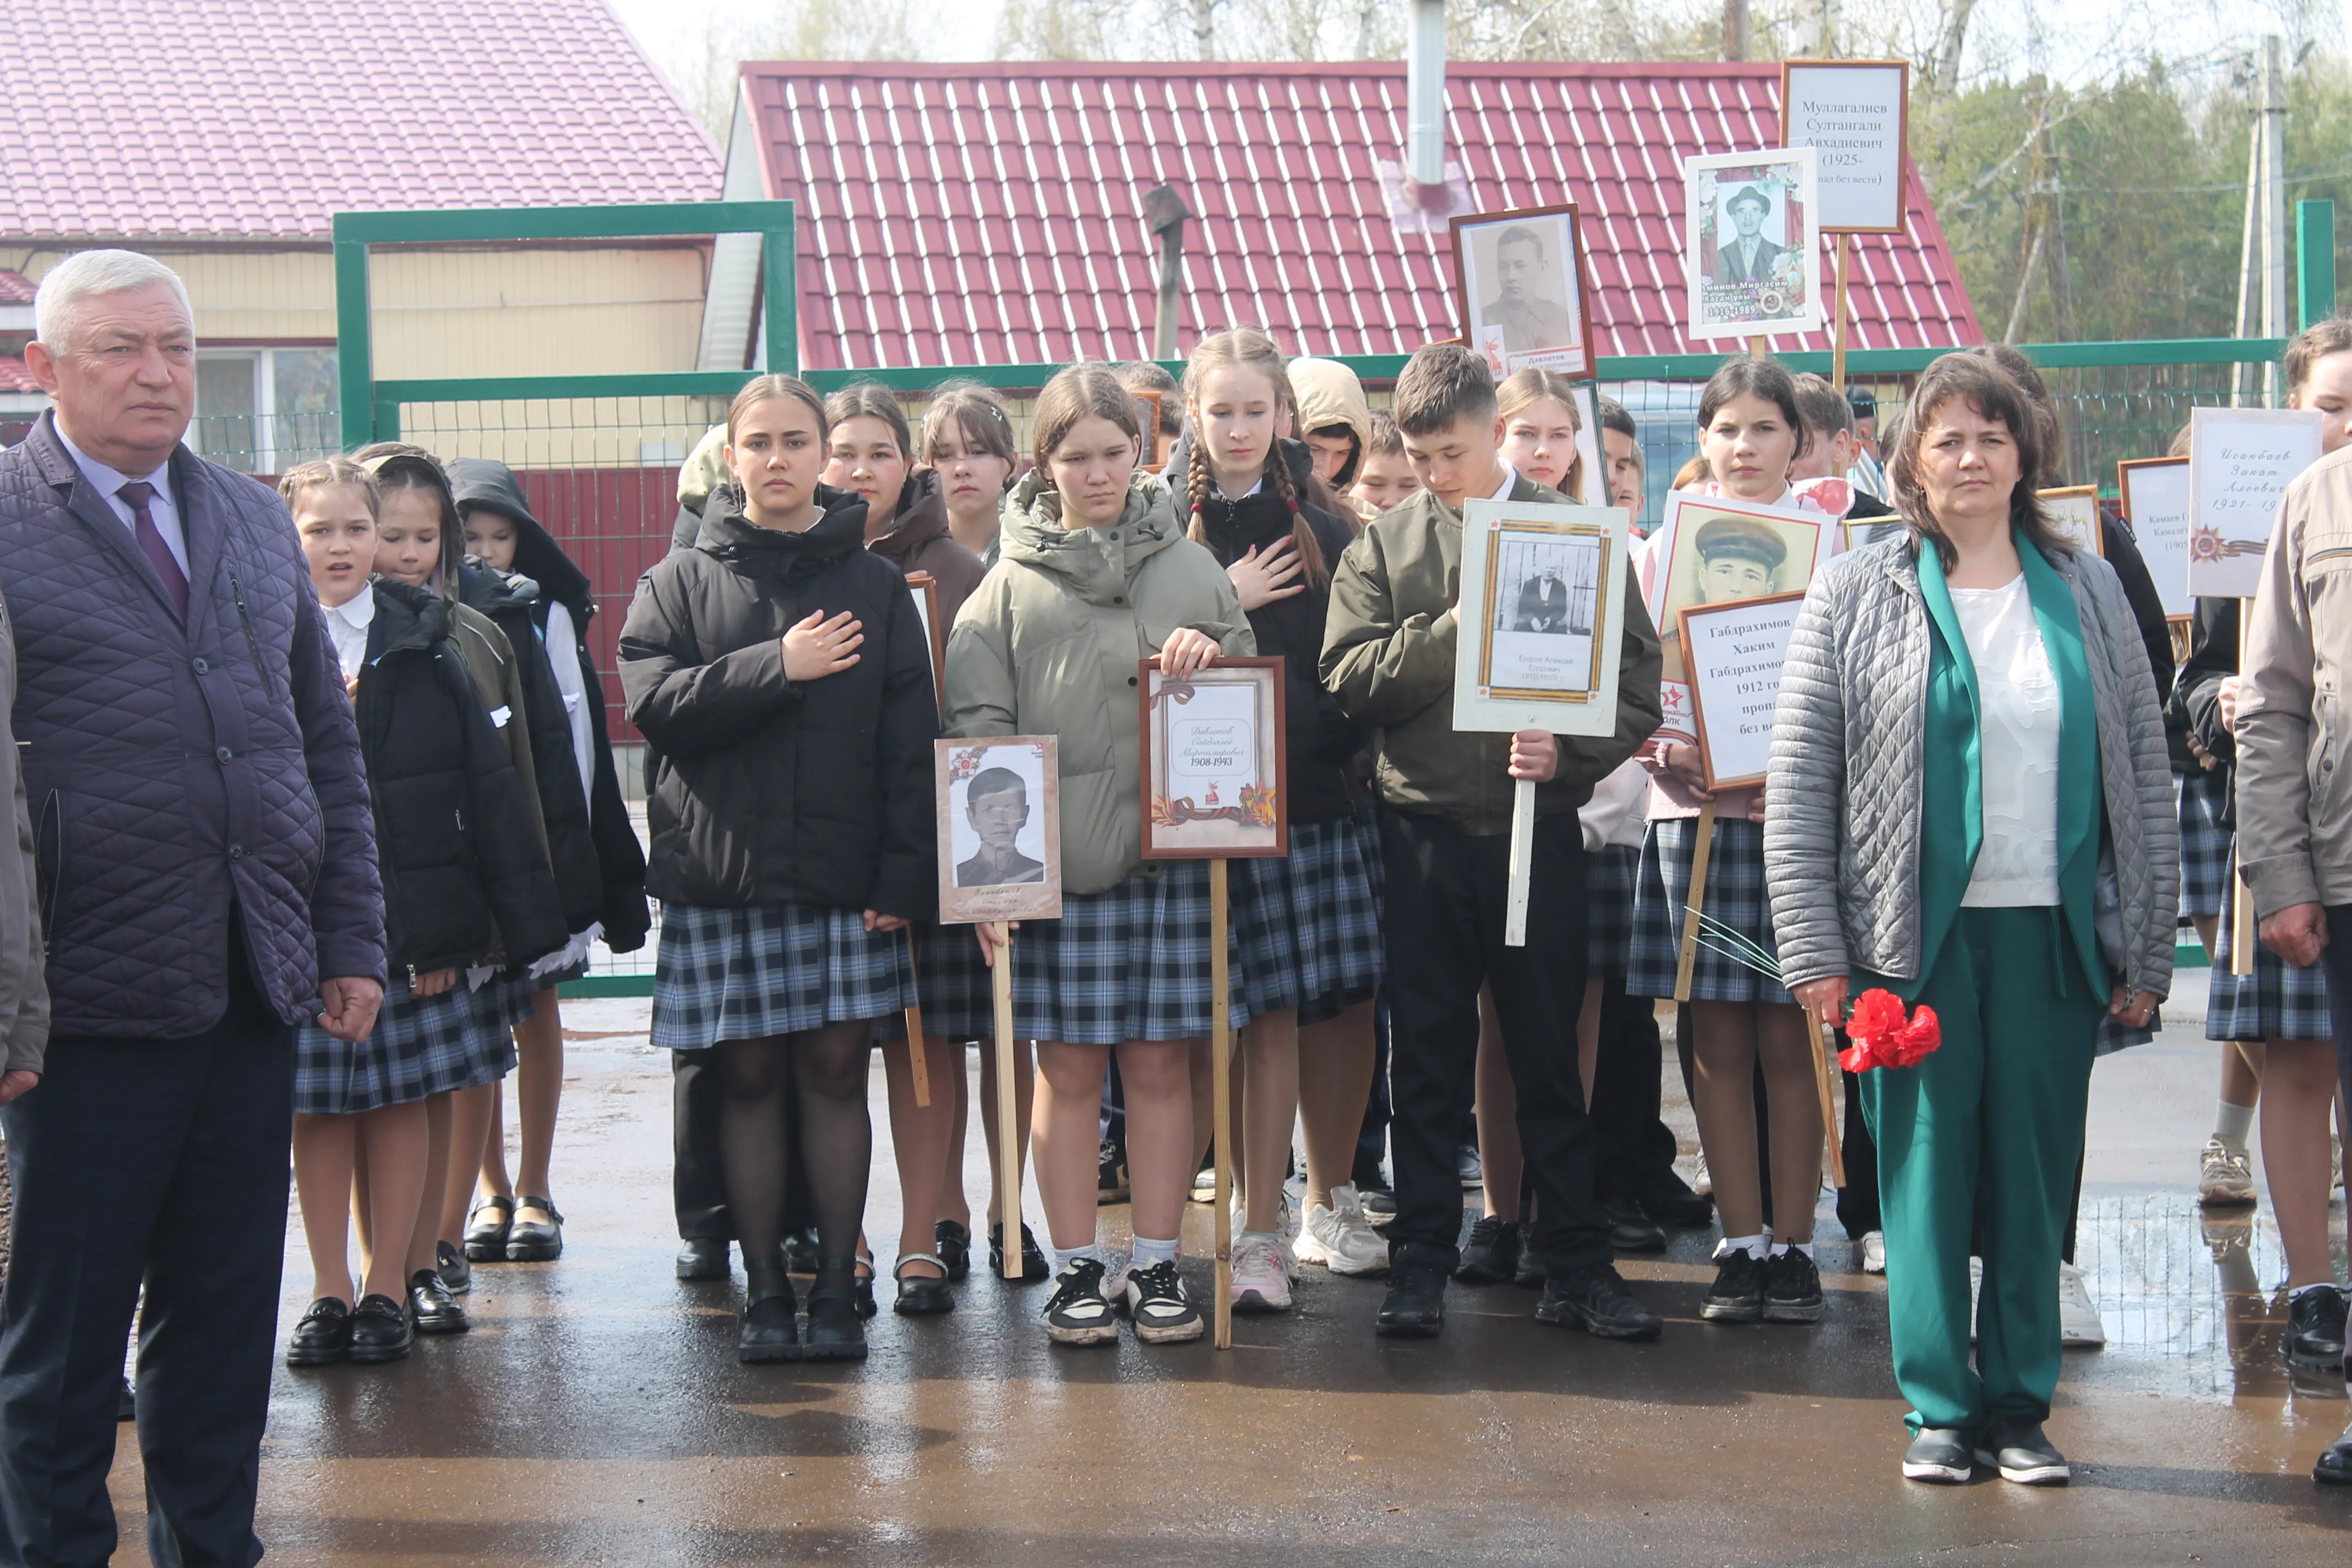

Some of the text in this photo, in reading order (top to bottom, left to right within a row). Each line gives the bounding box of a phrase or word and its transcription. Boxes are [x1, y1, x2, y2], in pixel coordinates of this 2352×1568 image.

[1803, 101, 1887, 115] Муллагалиев
[1806, 118, 1882, 133] Султангали
[1805, 137, 1882, 149] Авхадиевич
[1822, 154, 1863, 166] (1925-
[1836, 175, 1849, 183] без
[1709, 306, 1756, 316] 1916-1989
[1528, 354, 1565, 364] Давлетов
[2231, 465, 2279, 477] Зинат
[2149, 515, 2180, 524] Камаев
[1709, 619, 1790, 639] Габдрахимов
[1733, 641, 1775, 656] Хаким
[1519, 655, 1574, 665] Егоров Алексей
[1528, 664, 1561, 673] Егорович
[1736, 680, 1763, 694] 1912
[1663, 716, 1681, 726] ОЛК
[1191, 726, 1235, 735] Давлетов
[1740, 724, 1758, 735] без
[1191, 757, 1233, 767] 1908-1943
